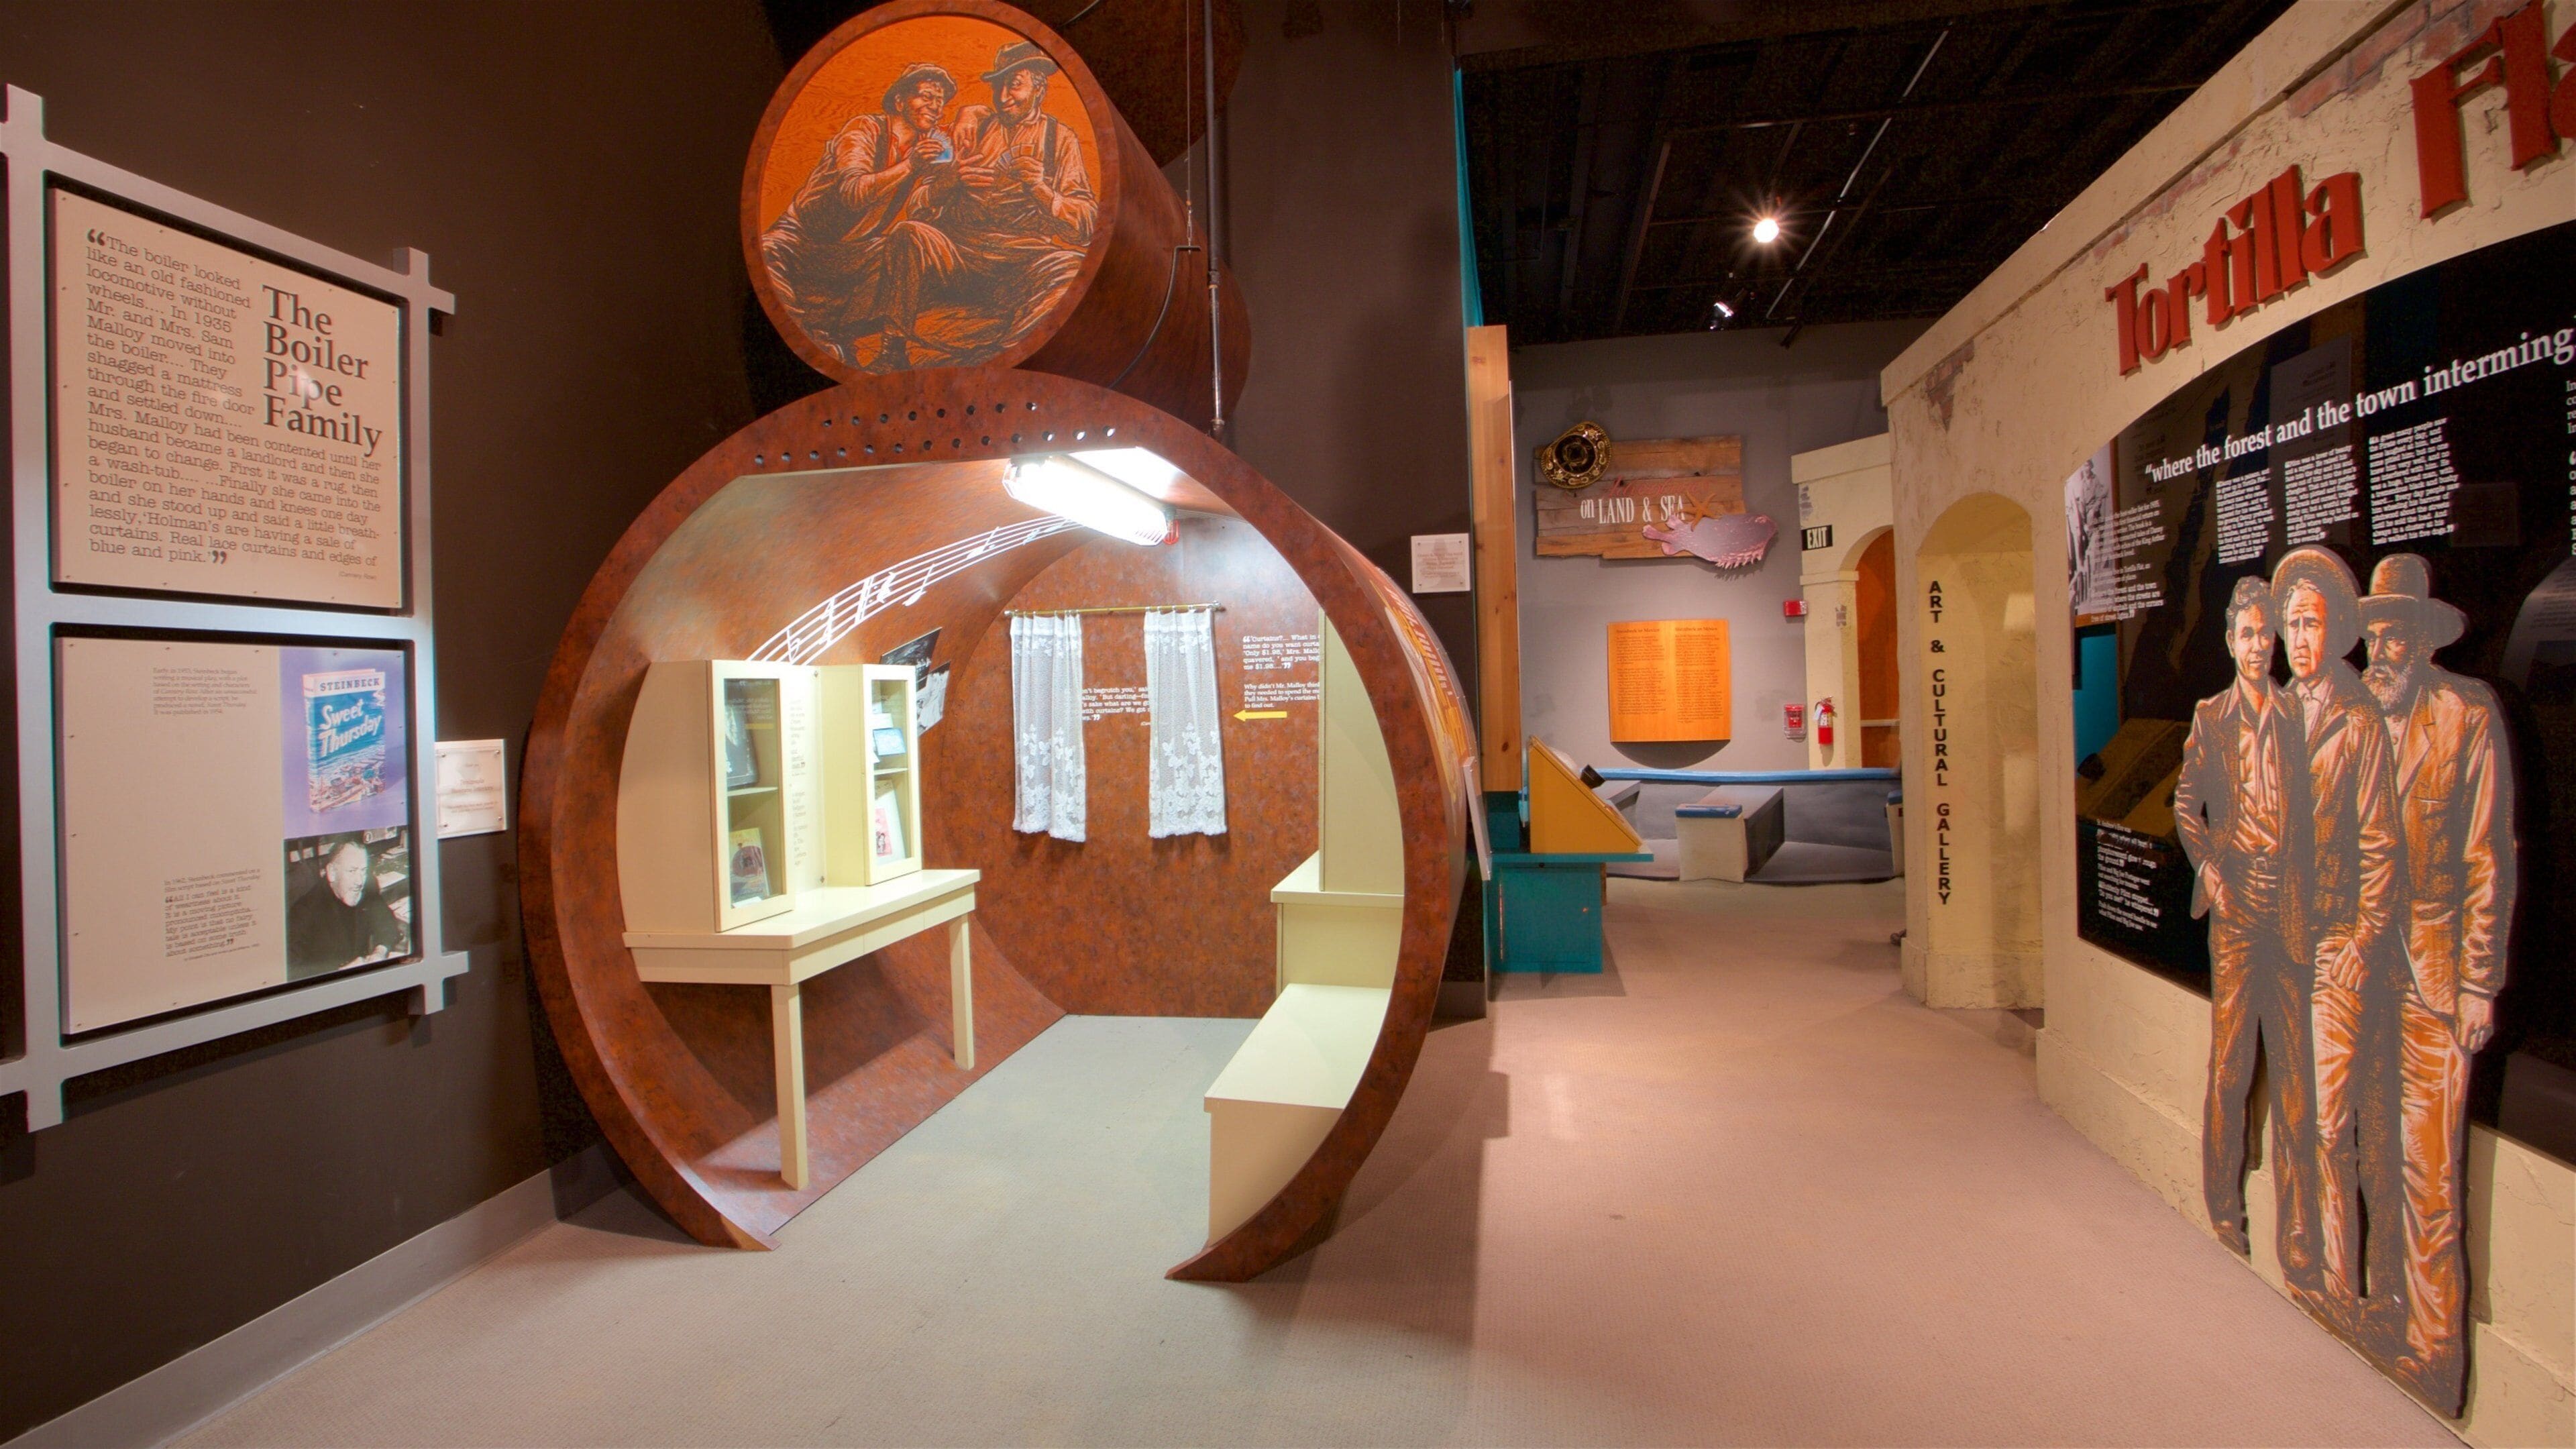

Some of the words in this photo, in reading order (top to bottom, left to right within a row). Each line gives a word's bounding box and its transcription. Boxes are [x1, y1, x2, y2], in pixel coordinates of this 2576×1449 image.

[85, 263, 175, 301] locomotive
[179, 294, 236, 319] without
[86, 246, 117, 266] like
[123, 261, 146, 276] an
[150, 269, 174, 285] old
[180, 276, 251, 309] fashioned
[144, 248, 189, 272] boiler
[193, 264, 241, 290] looked
[2104, 164, 2365, 376] Tortilla
[86, 297, 115, 317] Mr.
[122, 311, 154, 327] and
[159, 318, 195, 338] Mrs.
[201, 329, 233, 349] Sam
[170, 305, 187, 321] In
[195, 312, 231, 333] 1935
[262, 283, 332, 335] The
[87, 314, 145, 342] Malloy
[150, 334, 203, 356] moved
[207, 347, 235, 364] into
[87, 332, 115, 350] the
[189, 358, 227, 380] They
[262, 321, 368, 380] Boiler
[87, 351, 156, 377] shagged
[160, 370, 171, 380] a
[176, 373, 242, 397] mattress
[87, 366, 155, 393] through
[160, 384, 186, 400] the
[223, 398, 255, 415] door
[262, 357, 343, 411] Pipe
[87, 386, 121, 402] and
[126, 394, 179, 415] settled
[262, 393, 382, 457] Family
[87, 400, 127, 420] Mrs.
[134, 410, 188, 434] Malloy
[194, 423, 222, 439] had
[226, 429, 259, 447] been
[264, 439, 326, 460] contented
[329, 453, 357, 466] until
[361, 458, 381, 470] her
[87, 417, 160, 443] husband
[165, 433, 222, 455] became
[227, 448, 236, 458] a
[241, 447, 297, 469] landlord
[301, 462, 325, 474] and
[329, 466, 356, 480] then
[360, 472, 379, 484] she
[2196, 444, 2221, 473] the
[2224, 424, 2272, 460] forest
[2276, 407, 2312, 443] and
[2316, 400, 2351, 430] the
[2355, 380, 2417, 417] town
[87, 435, 139, 455] began
[144, 446, 160, 460] to
[166, 451, 222, 471] change.
[229, 461, 263, 477] First
[267, 468, 277, 480] it
[281, 473, 307, 485] was
[311, 478, 319, 487] a
[352, 484, 378, 498] then
[88, 455, 100, 466] a
[272, 485, 295, 498] she
[299, 491, 331, 504] came
[336, 495, 358, 508] into
[362, 500, 380, 512] the
[87, 469, 137, 488] boiler
[142, 481, 163, 493] on
[168, 482, 196, 497] her
[201, 487, 245, 505] hands
[250, 498, 275, 509] and
[280, 500, 317, 516] knees
[321, 508, 342, 519] one
[346, 511, 368, 525] day
[89, 490, 121, 503] and
[127, 493, 156, 508] she
[162, 499, 203, 515] stood
[207, 506, 227, 520] up
[231, 511, 258, 522] and
[263, 515, 290, 527] said
[294, 519, 303, 528] a
[307, 519, 334, 533] little
[1580, 498, 1595, 519] on
[1598, 497, 1635, 524] LAND
[1642, 496, 1652, 522] &
[1660, 494, 1686, 521] SEA
[89, 524, 162, 541] curtains.
[169, 531, 203, 546] Real
[208, 535, 237, 550] lace
[241, 543, 297, 557] curtains
[301, 549, 325, 560] and
[329, 551, 362, 565] edges
[365, 555, 377, 566] of
[89, 538, 125, 554] blue
[131, 545, 163, 558] and
[225, 525, 249, 536] are
[254, 526, 299, 545] having
[303, 535, 312, 544] a
[316, 537, 339, 547] sale
[343, 539, 356, 549] of
[1807, 527, 1828, 549] EXIT
[1929, 580, 1942, 623] ART
[1931, 640, 1945, 653] &
[319, 678, 380, 692] STEINBECK
[1287, 682, 1305, 690] Malloy
[319, 698, 364, 730] Sweet
[319, 715, 382, 757] Thursday
[1933, 669, 1949, 787] CULTURAL
[1936, 802, 1951, 905] GALLERY
